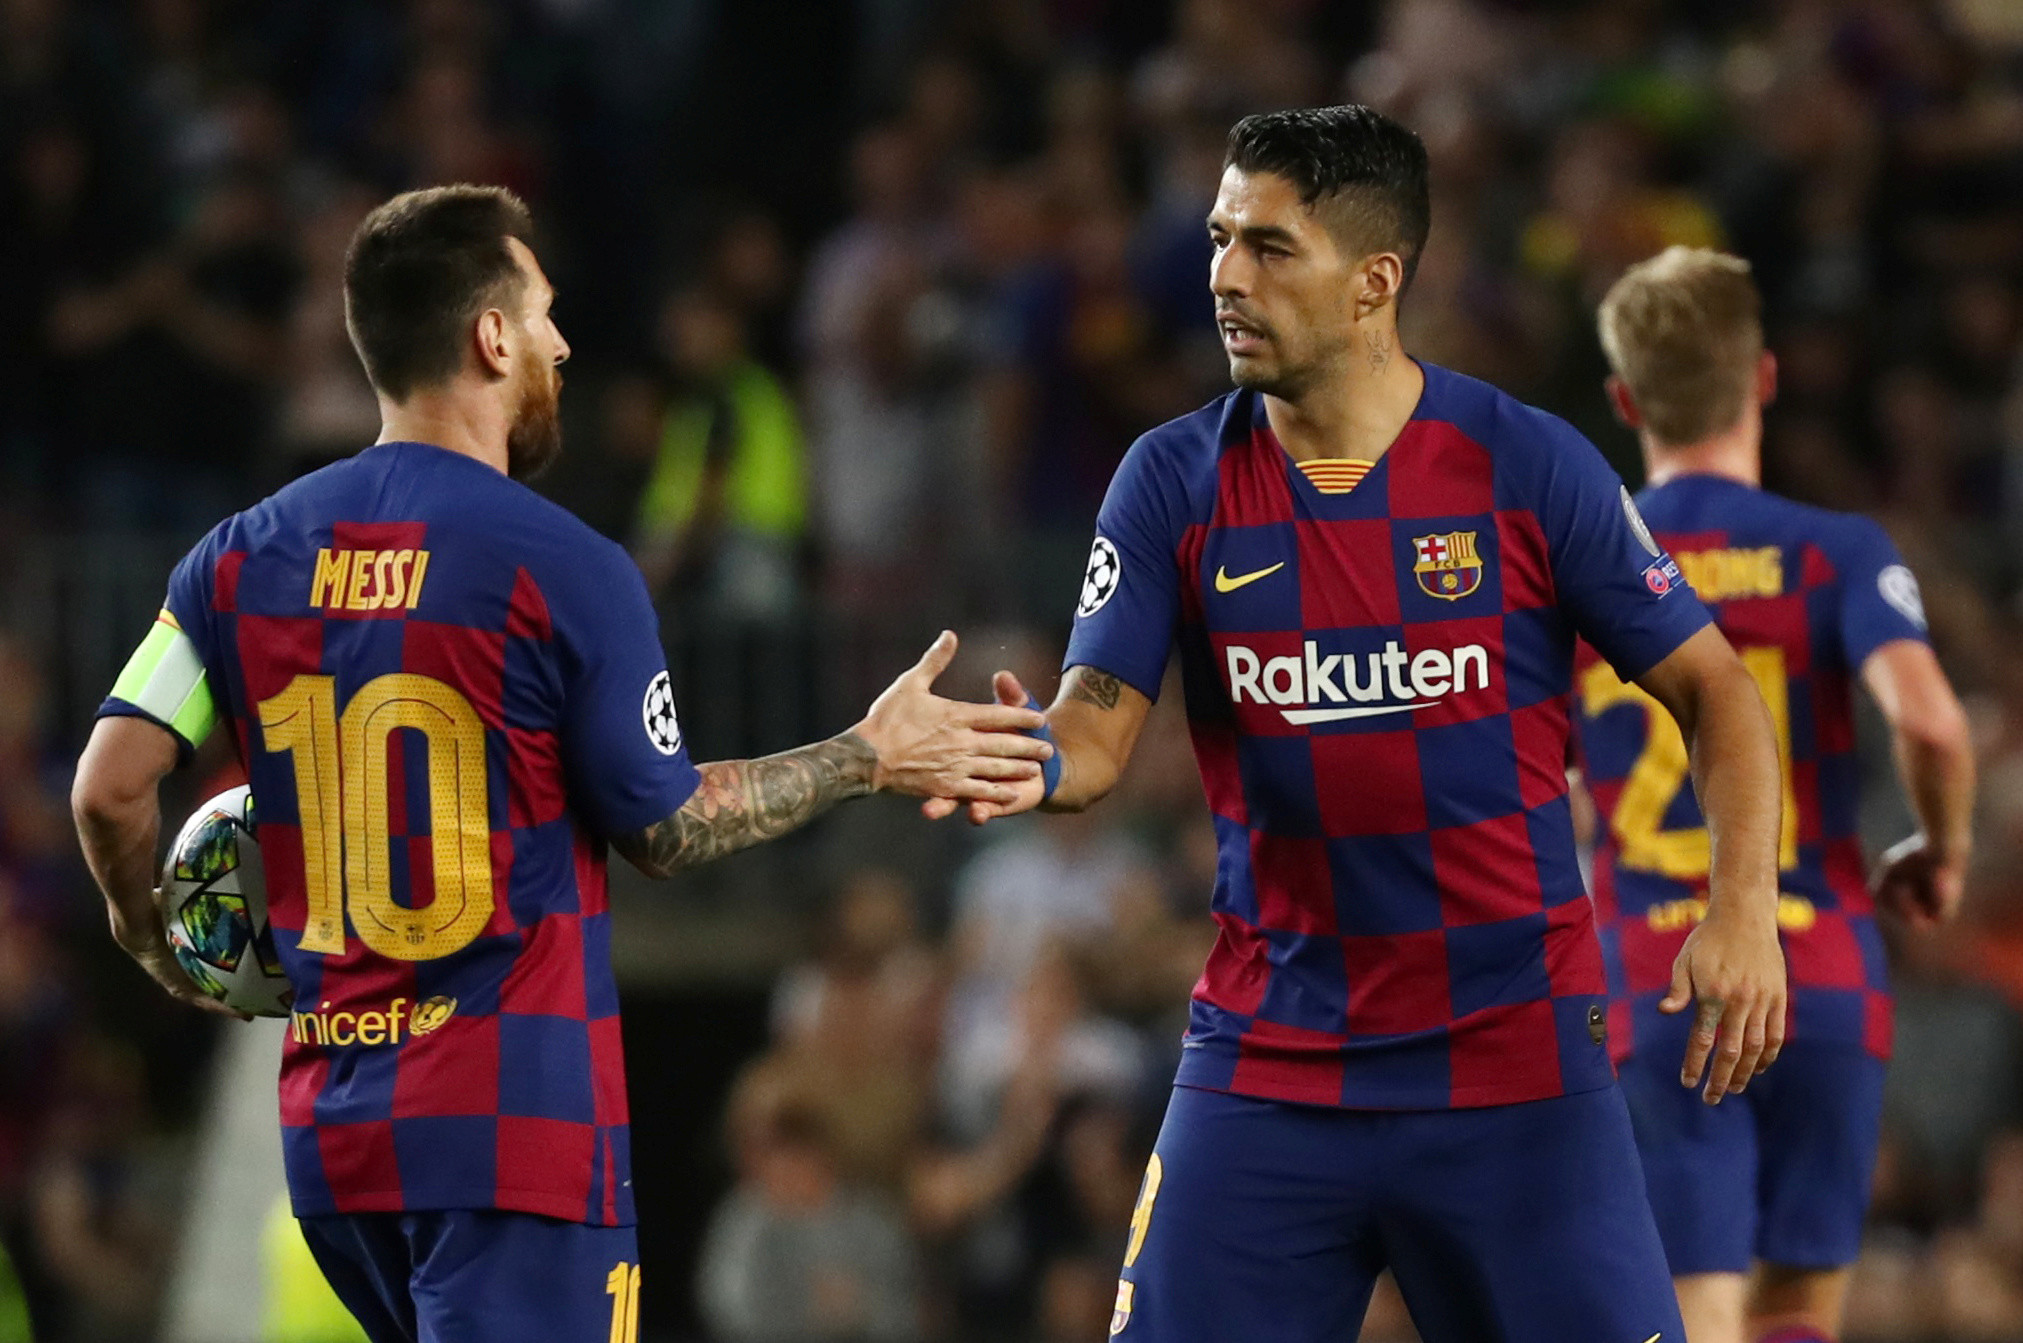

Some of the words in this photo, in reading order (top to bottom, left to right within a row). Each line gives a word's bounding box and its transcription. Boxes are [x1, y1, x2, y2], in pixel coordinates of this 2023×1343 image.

[309, 547, 430, 610] MESSI
[1226, 640, 1489, 706] Rakuten
[258, 672, 496, 962] 10
[292, 998, 407, 1046] unicef
